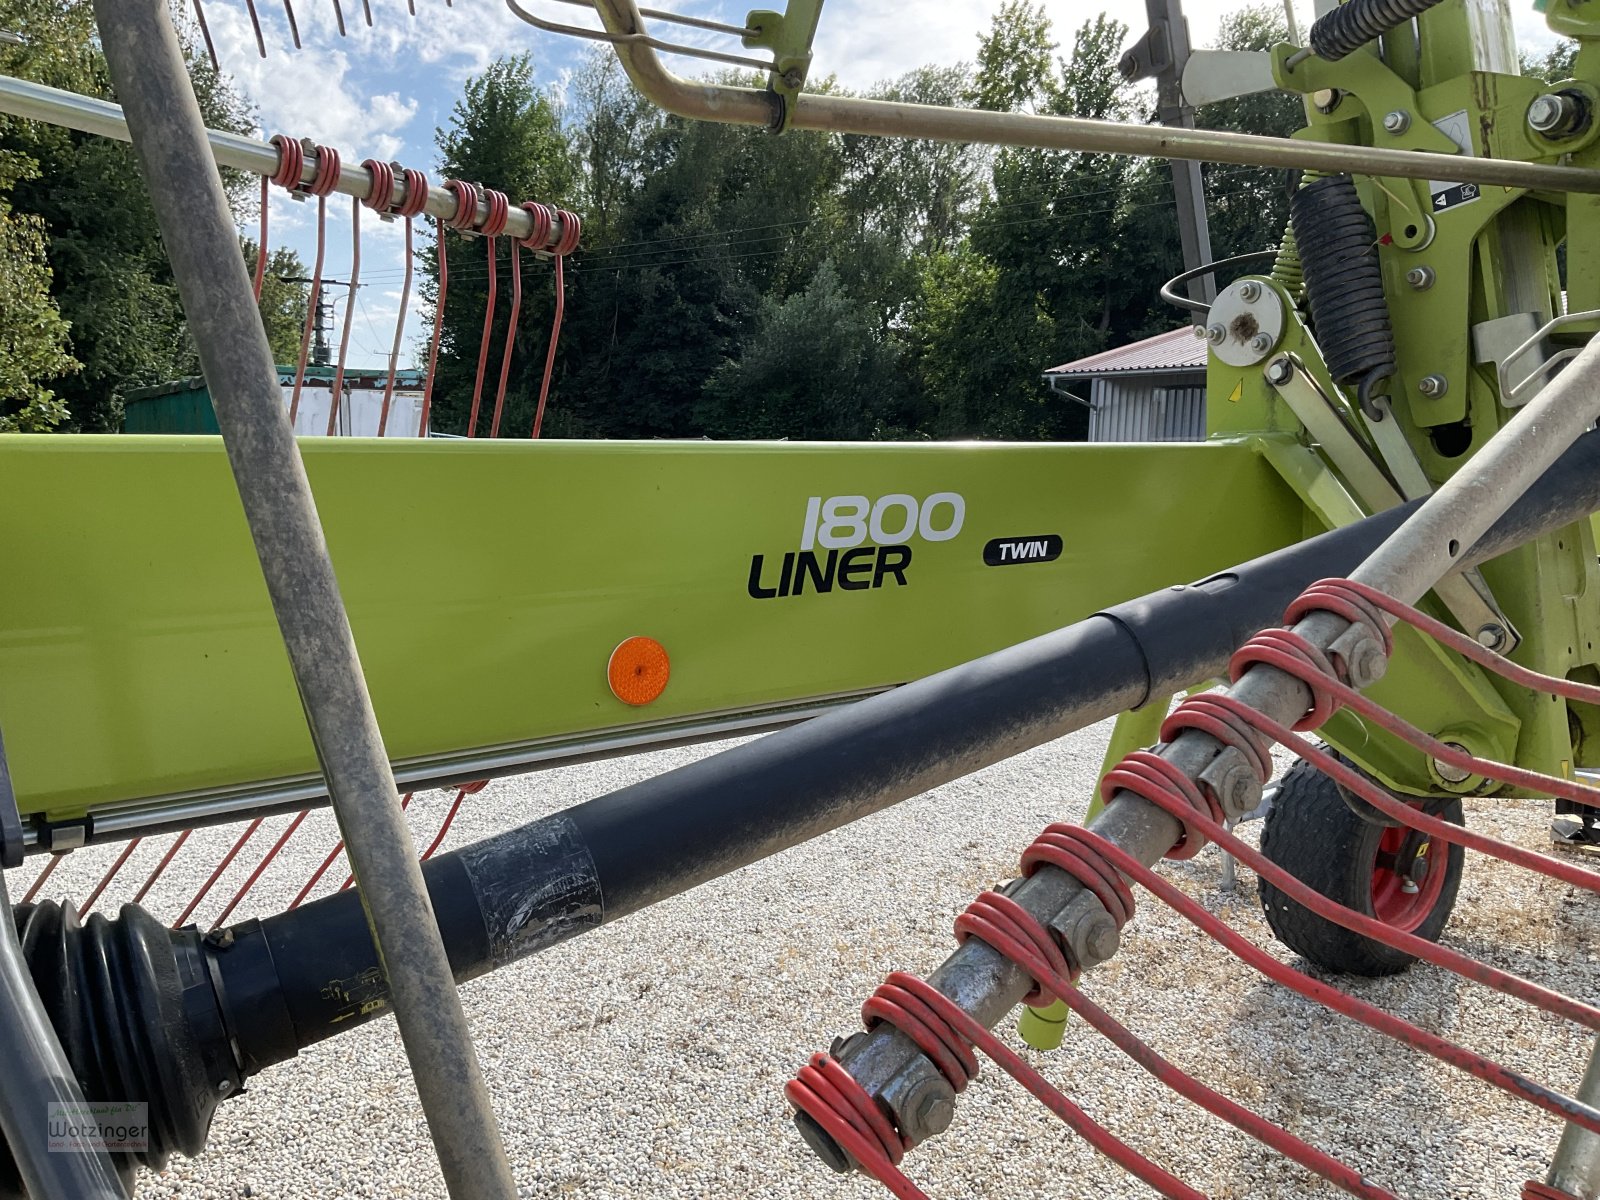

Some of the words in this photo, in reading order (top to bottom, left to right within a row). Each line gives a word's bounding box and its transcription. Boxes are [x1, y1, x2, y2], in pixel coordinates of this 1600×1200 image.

[800, 492, 966, 551] 1800
[747, 544, 912, 599] LINER
[999, 540, 1049, 561] TWIN
